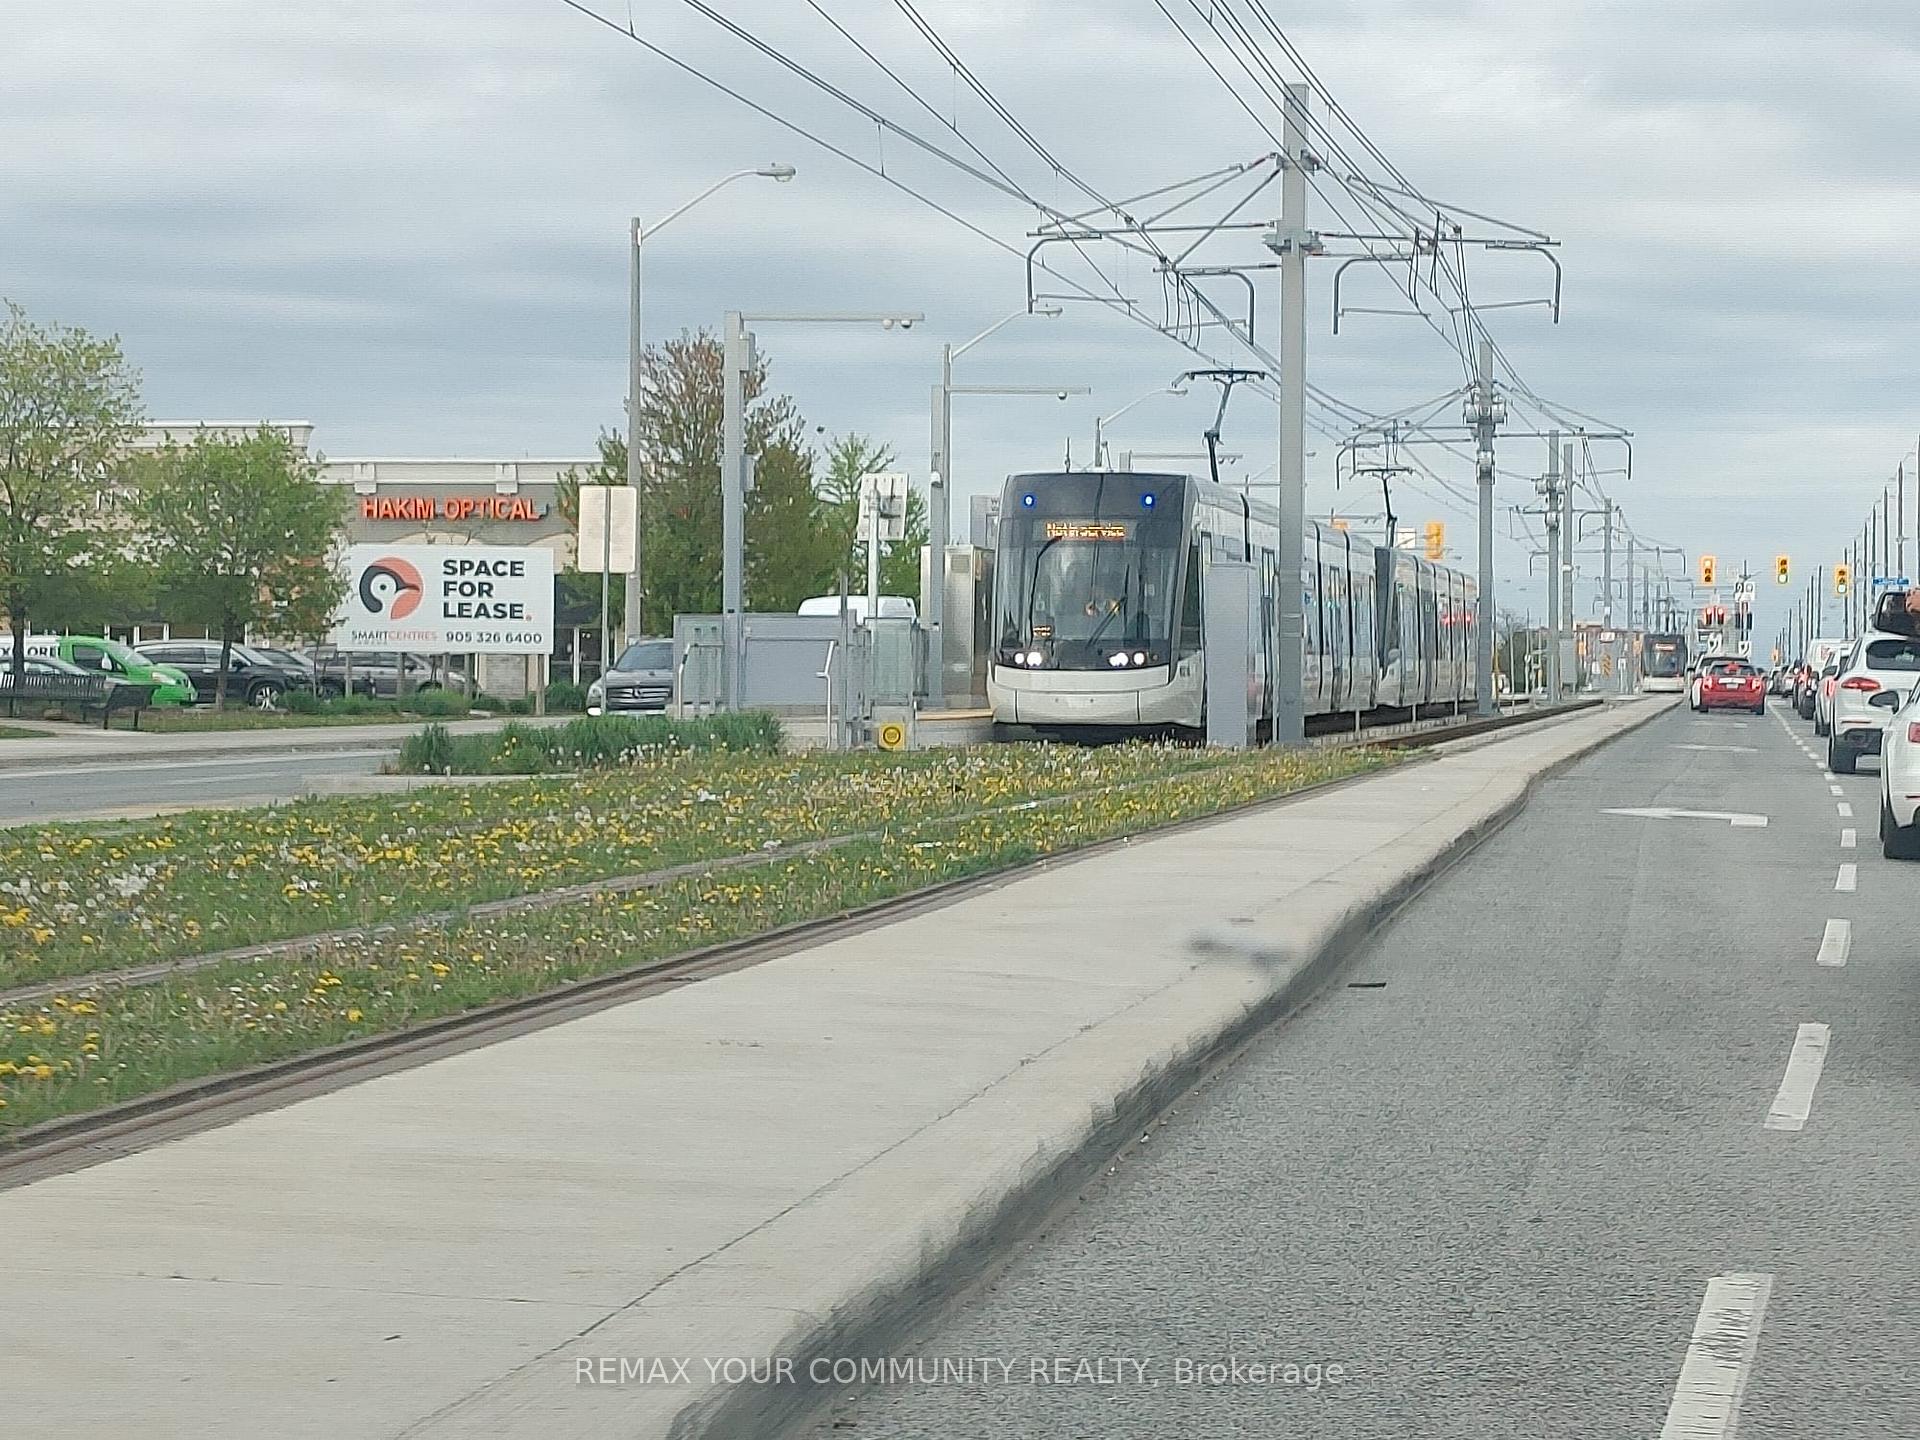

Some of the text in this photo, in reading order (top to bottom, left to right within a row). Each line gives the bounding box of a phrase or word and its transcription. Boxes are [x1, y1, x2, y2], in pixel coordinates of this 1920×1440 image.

[363, 497, 541, 521] HAKIM OPTICAL
[443, 559, 525, 577] SPACE
[443, 581, 494, 598] FOR
[446, 631, 542, 644] 905 326 6400
